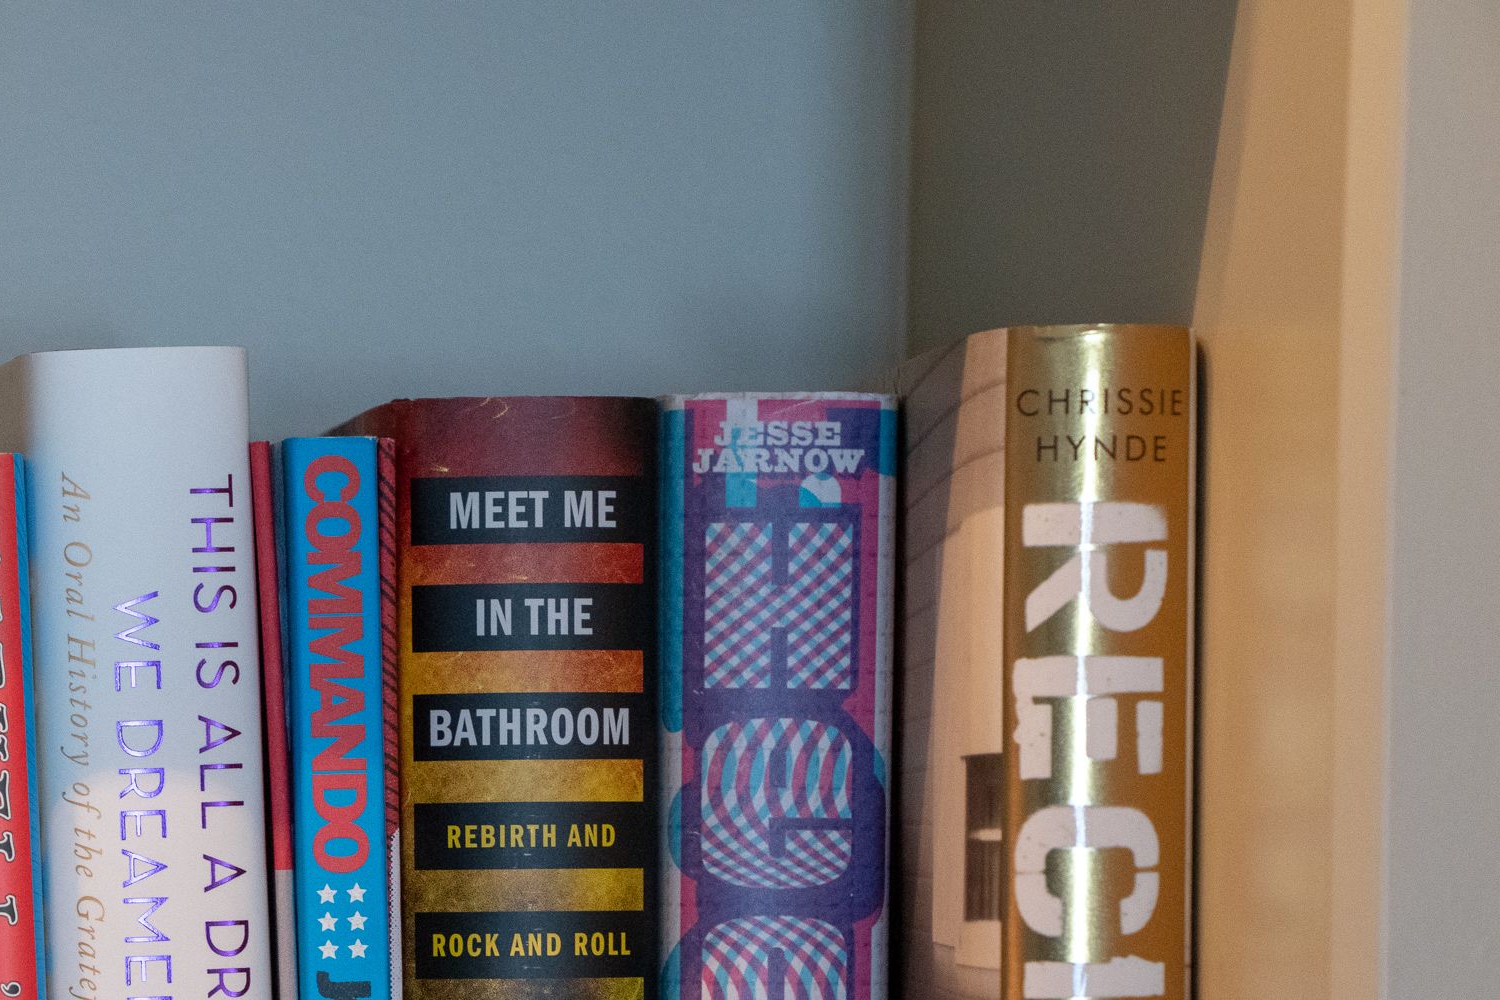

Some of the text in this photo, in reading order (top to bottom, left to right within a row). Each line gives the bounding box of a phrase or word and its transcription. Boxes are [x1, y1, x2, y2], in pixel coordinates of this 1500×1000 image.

[1016, 387, 1184, 418] CHRISSIE
[713, 421, 842, 447] JESSE
[1036, 435, 1168, 463] HYNDE
[692, 448, 865, 475] JARNOW
[61, 472, 91, 522] An
[449, 490, 617, 530] MEET ME
[189, 473, 237, 615] THIS
[63, 540, 93, 626] Oral
[476, 597, 594, 636] IN THE
[113, 591, 162, 692] WE
[194, 641, 241, 689] IS
[303, 455, 370, 873] COMMANDO
[61, 635, 97, 767] History
[429, 707, 631, 747] BATHROOM
[197, 714, 246, 830] ALL
[62, 782, 101, 820] of
[74, 826, 102, 877] the
[446, 824, 616, 849] REBIRTH AND
[202, 853, 247, 893] A
[432, 932, 631, 958] ROCK AND ROLL
